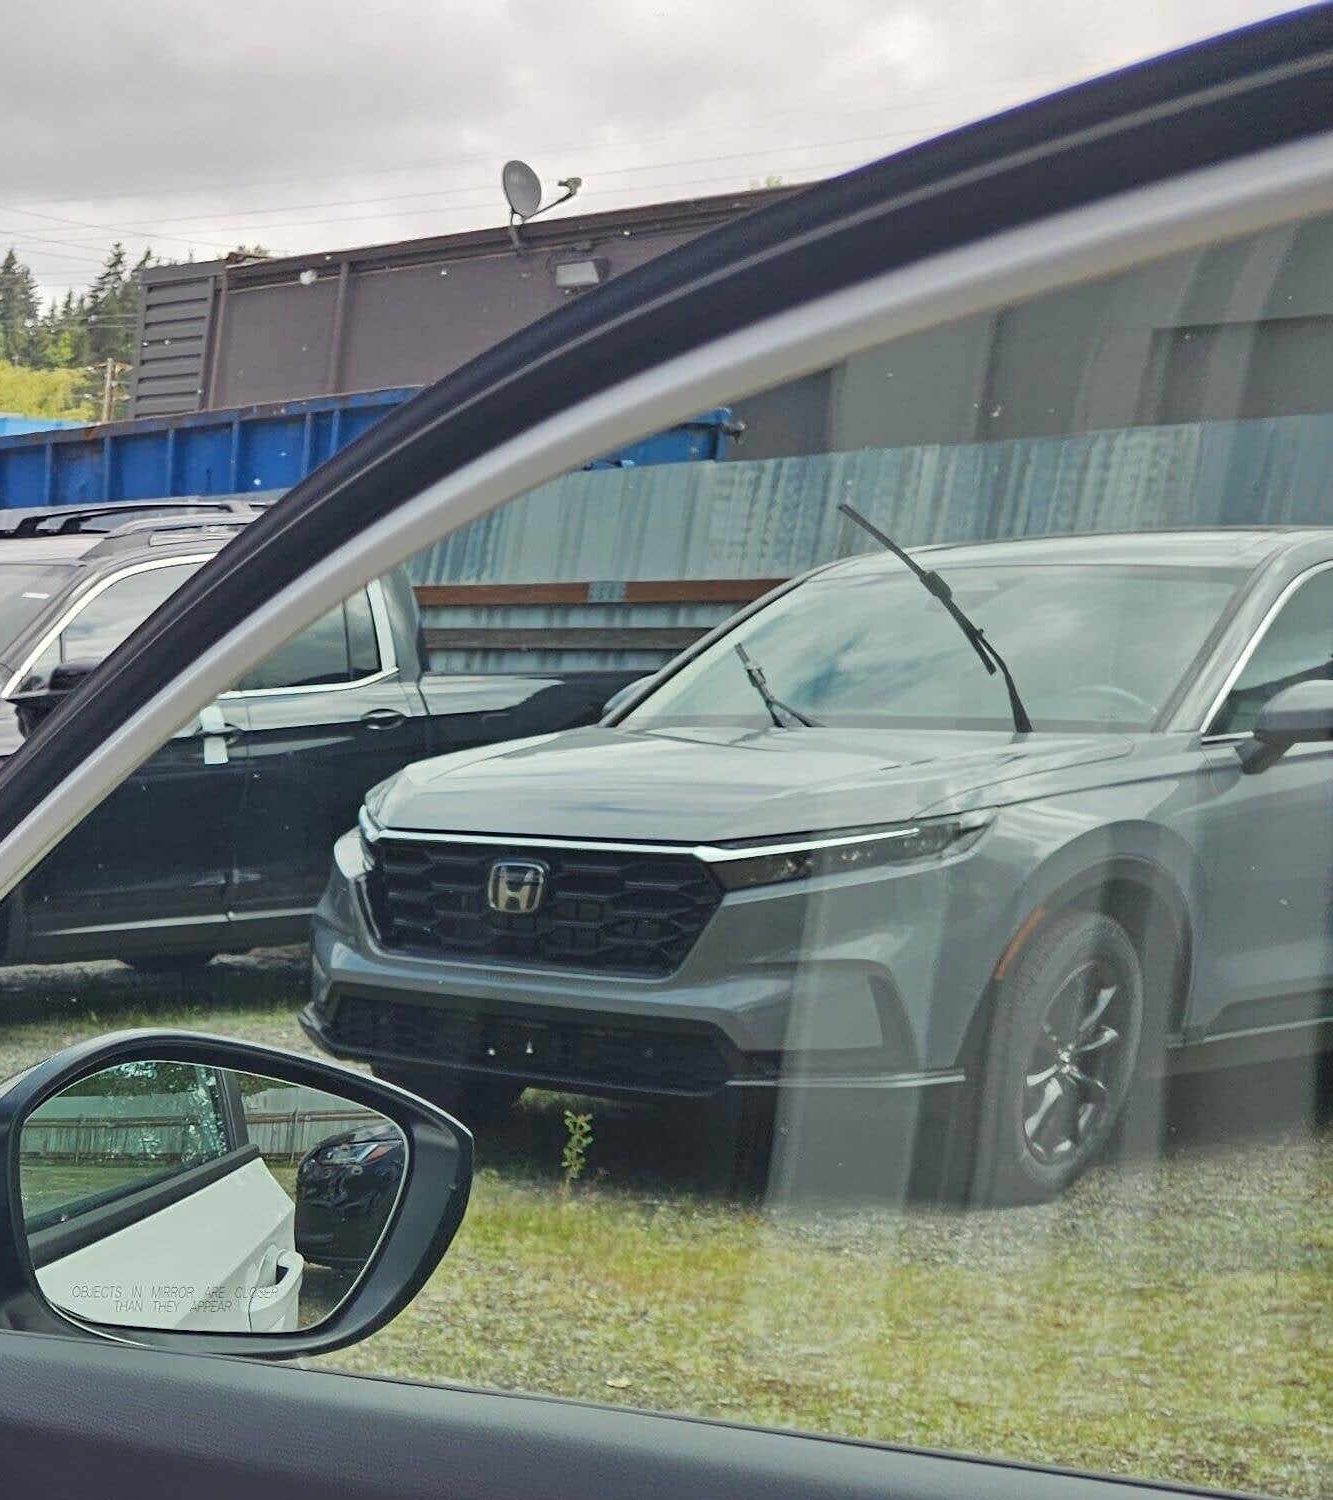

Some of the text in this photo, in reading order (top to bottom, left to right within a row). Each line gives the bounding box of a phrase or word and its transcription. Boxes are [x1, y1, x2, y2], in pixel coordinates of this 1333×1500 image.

[72, 1286, 278, 1299] OBJECTS IN MIRROR ARE CLOSER
[113, 1300, 233, 1313] THAN THEY APPEAR
